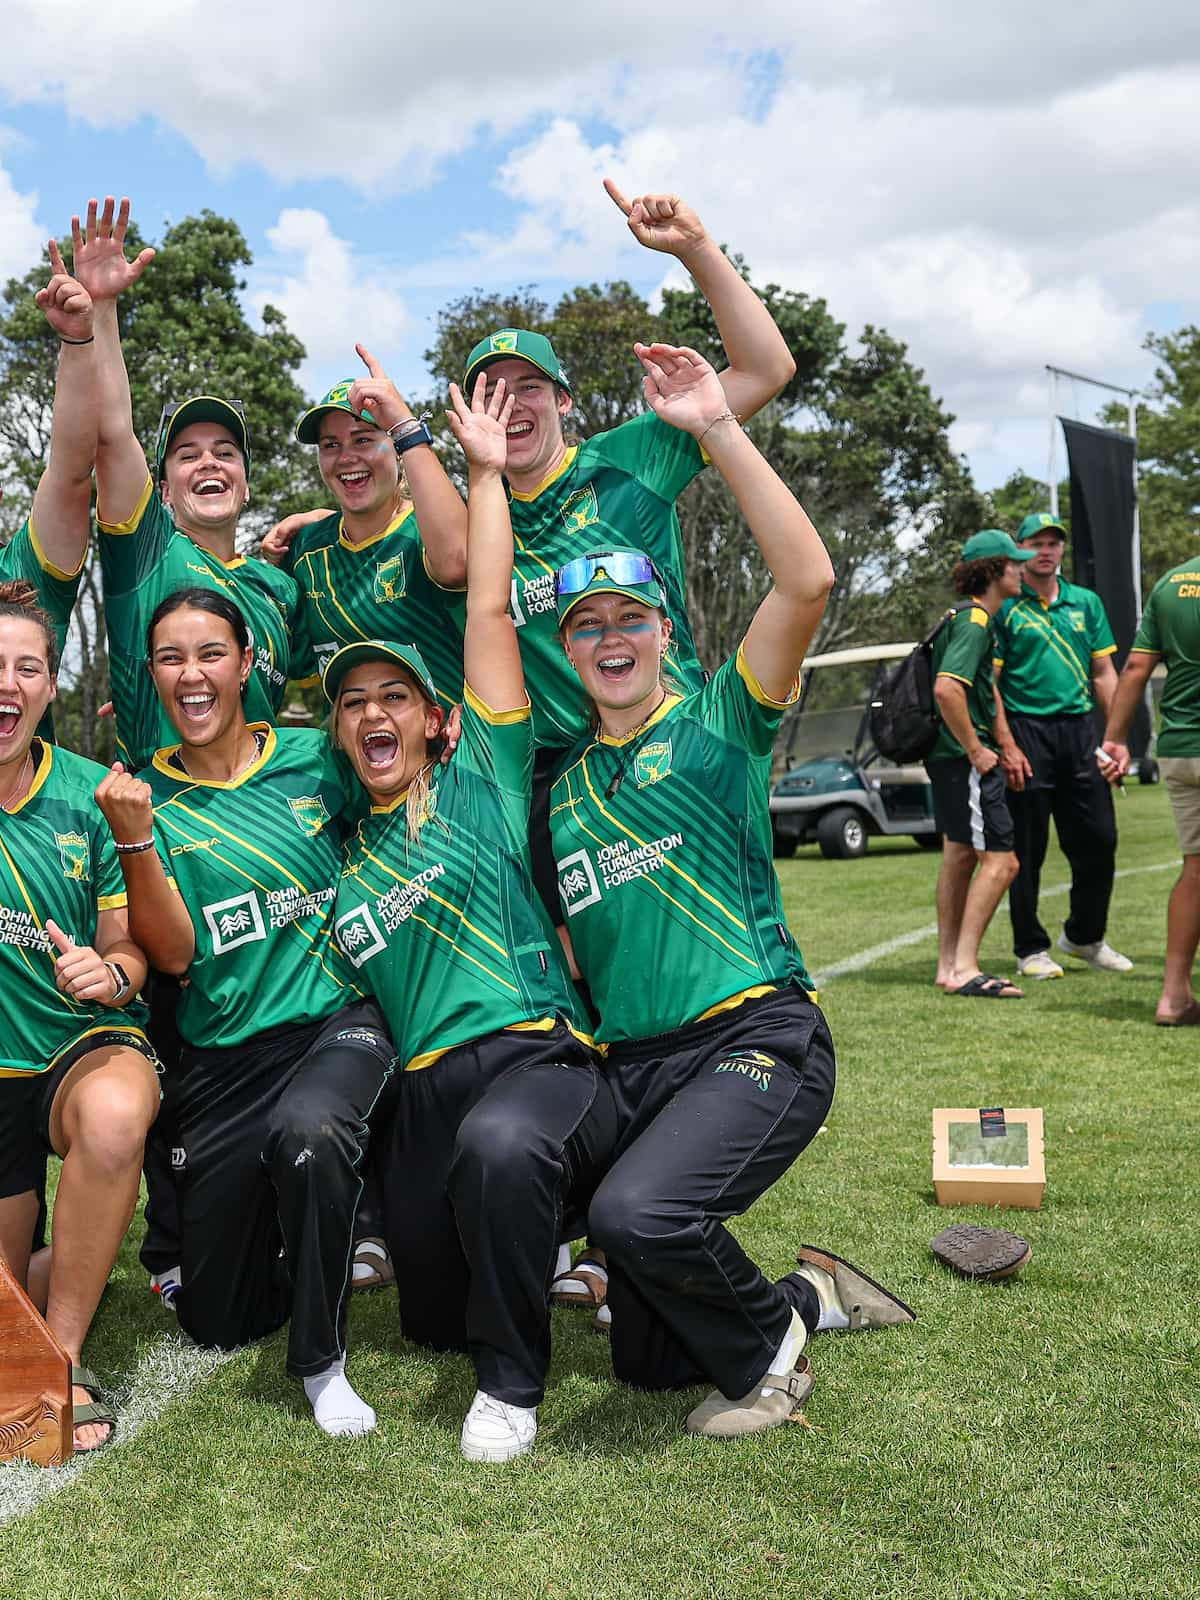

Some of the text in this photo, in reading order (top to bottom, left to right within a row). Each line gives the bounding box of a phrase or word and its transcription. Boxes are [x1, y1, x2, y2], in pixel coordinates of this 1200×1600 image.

[522, 574, 555, 593] JOHN
[527, 597, 557, 616] FORE
[170, 837, 222, 856] OOGA
[597, 840, 630, 864] JOHN
[598, 832, 683, 877] TURKINGTON
[603, 854, 665, 890] FORESTRY
[265, 887, 300, 905] JOHN
[376, 882, 401, 913] JOHN
[384, 885, 430, 935] FORESTRY
[712, 1062, 772, 1092] HINDS
